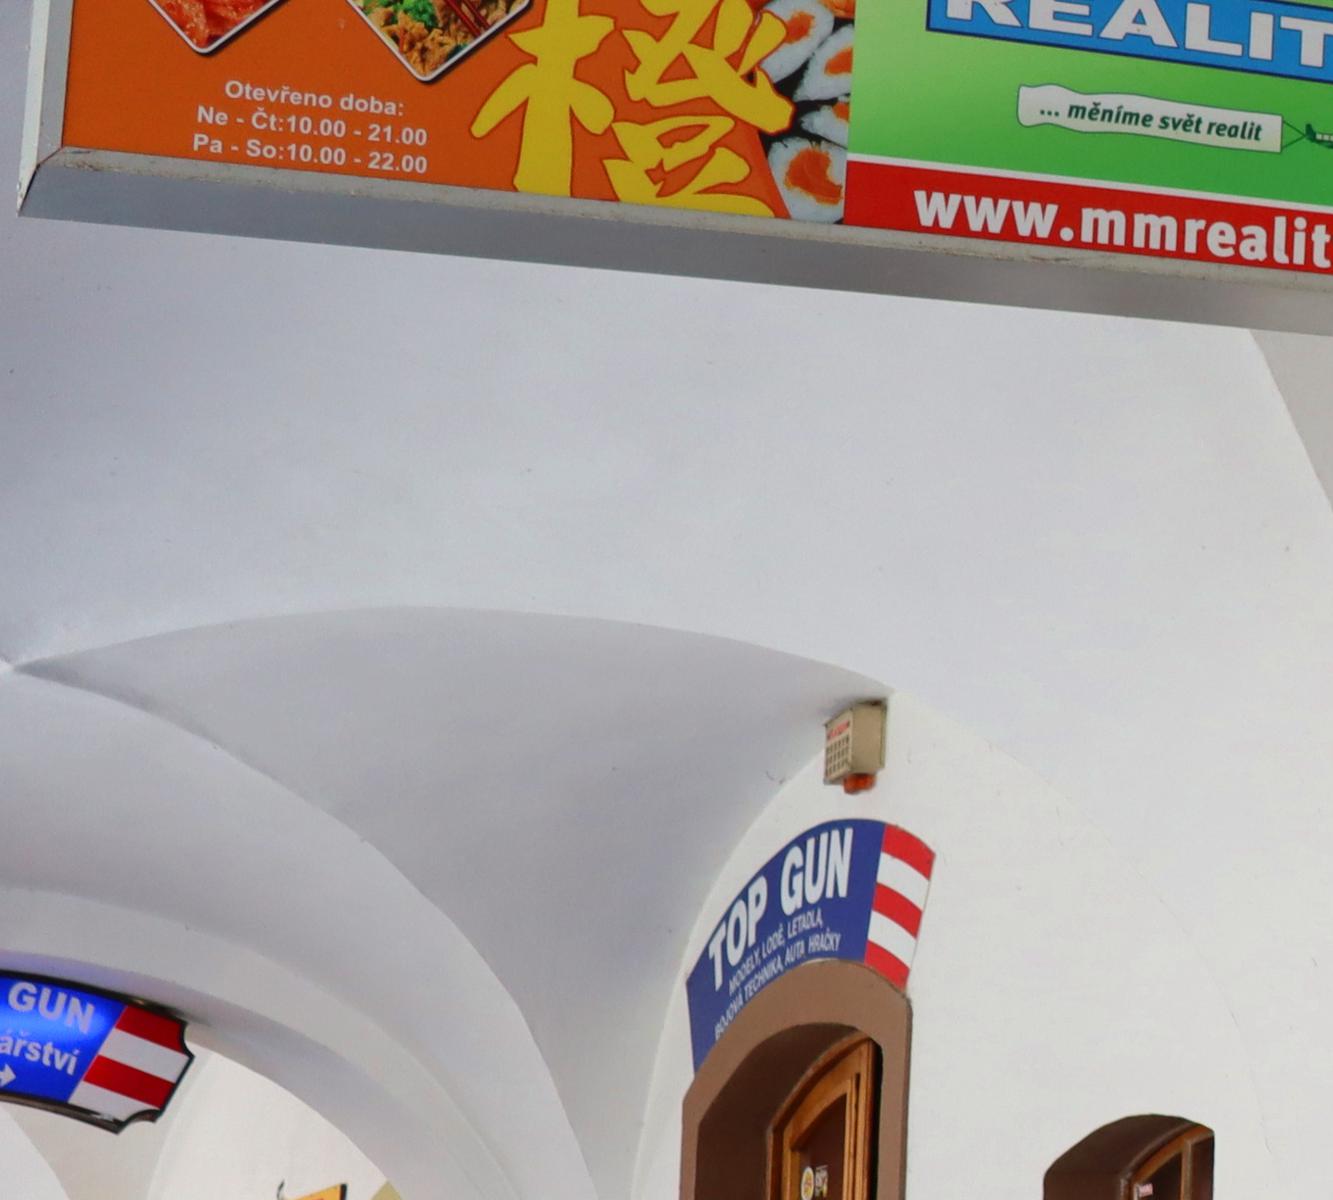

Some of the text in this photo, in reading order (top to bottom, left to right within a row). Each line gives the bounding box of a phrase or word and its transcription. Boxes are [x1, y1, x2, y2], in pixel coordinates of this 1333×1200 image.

[224, 80, 404, 117] Otevřeno doba:
[196, 105, 229, 126] Ne
[251, 107, 346, 138] Čt:10.00
[367, 123, 428, 146] 21.00
[1067, 100, 1154, 131] měníme
[1158, 107, 1202, 135] svět
[1207, 116, 1263, 142] realit
[192, 133, 224, 154] Pa
[246, 139, 346, 166] So:10.00
[367, 151, 428, 174] 22.00
[708, 828, 853, 991] TOP GUN
[8, 981, 95, 1035] GUN
